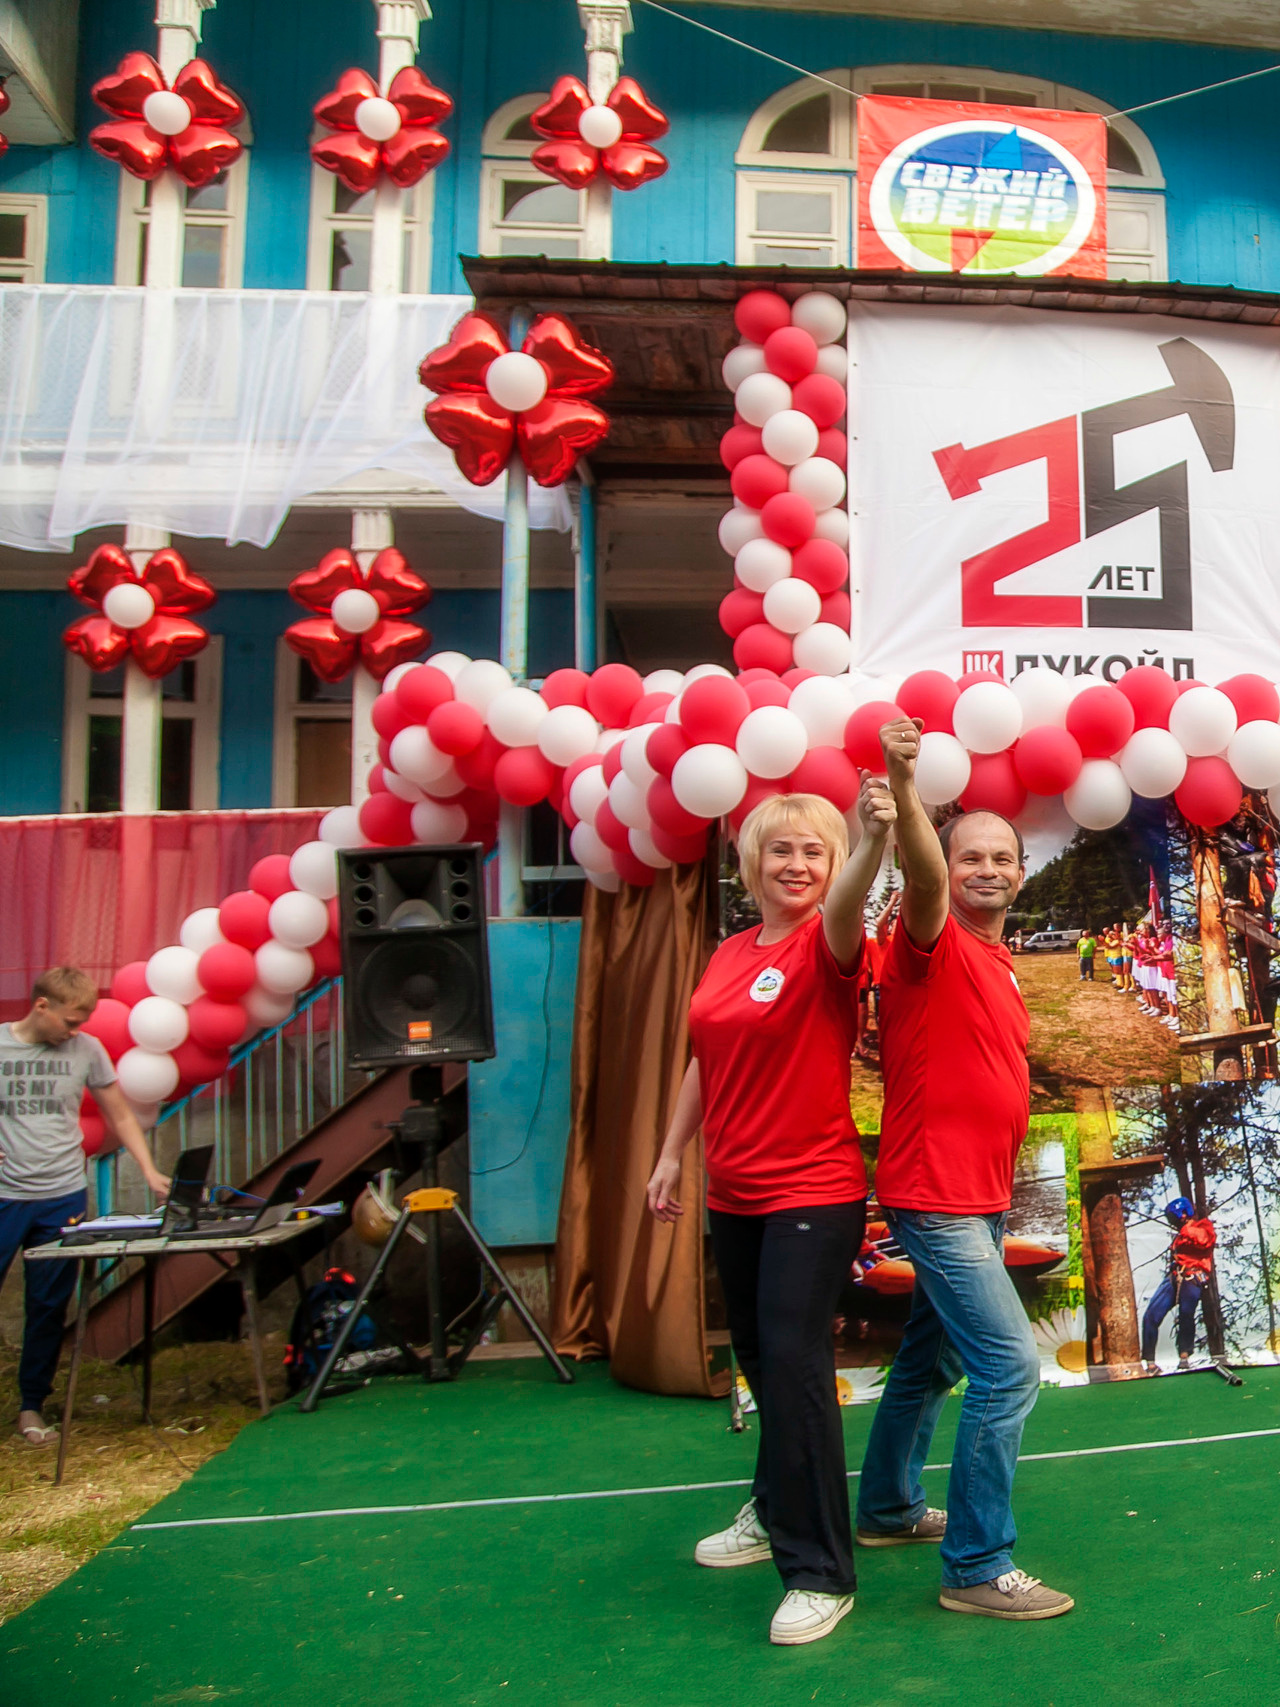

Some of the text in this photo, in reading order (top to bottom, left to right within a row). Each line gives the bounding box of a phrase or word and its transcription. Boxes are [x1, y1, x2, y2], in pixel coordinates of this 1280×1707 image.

[901, 162, 1068, 198] СВЕЖИЙ
[901, 188, 1068, 231] ВЕТЕР
[932, 337, 1235, 630] 25
[1088, 566, 1154, 591] ЛЕТ
[0, 1060, 71, 1076] OOTBALL
[8, 1080, 57, 1096] IS MY
